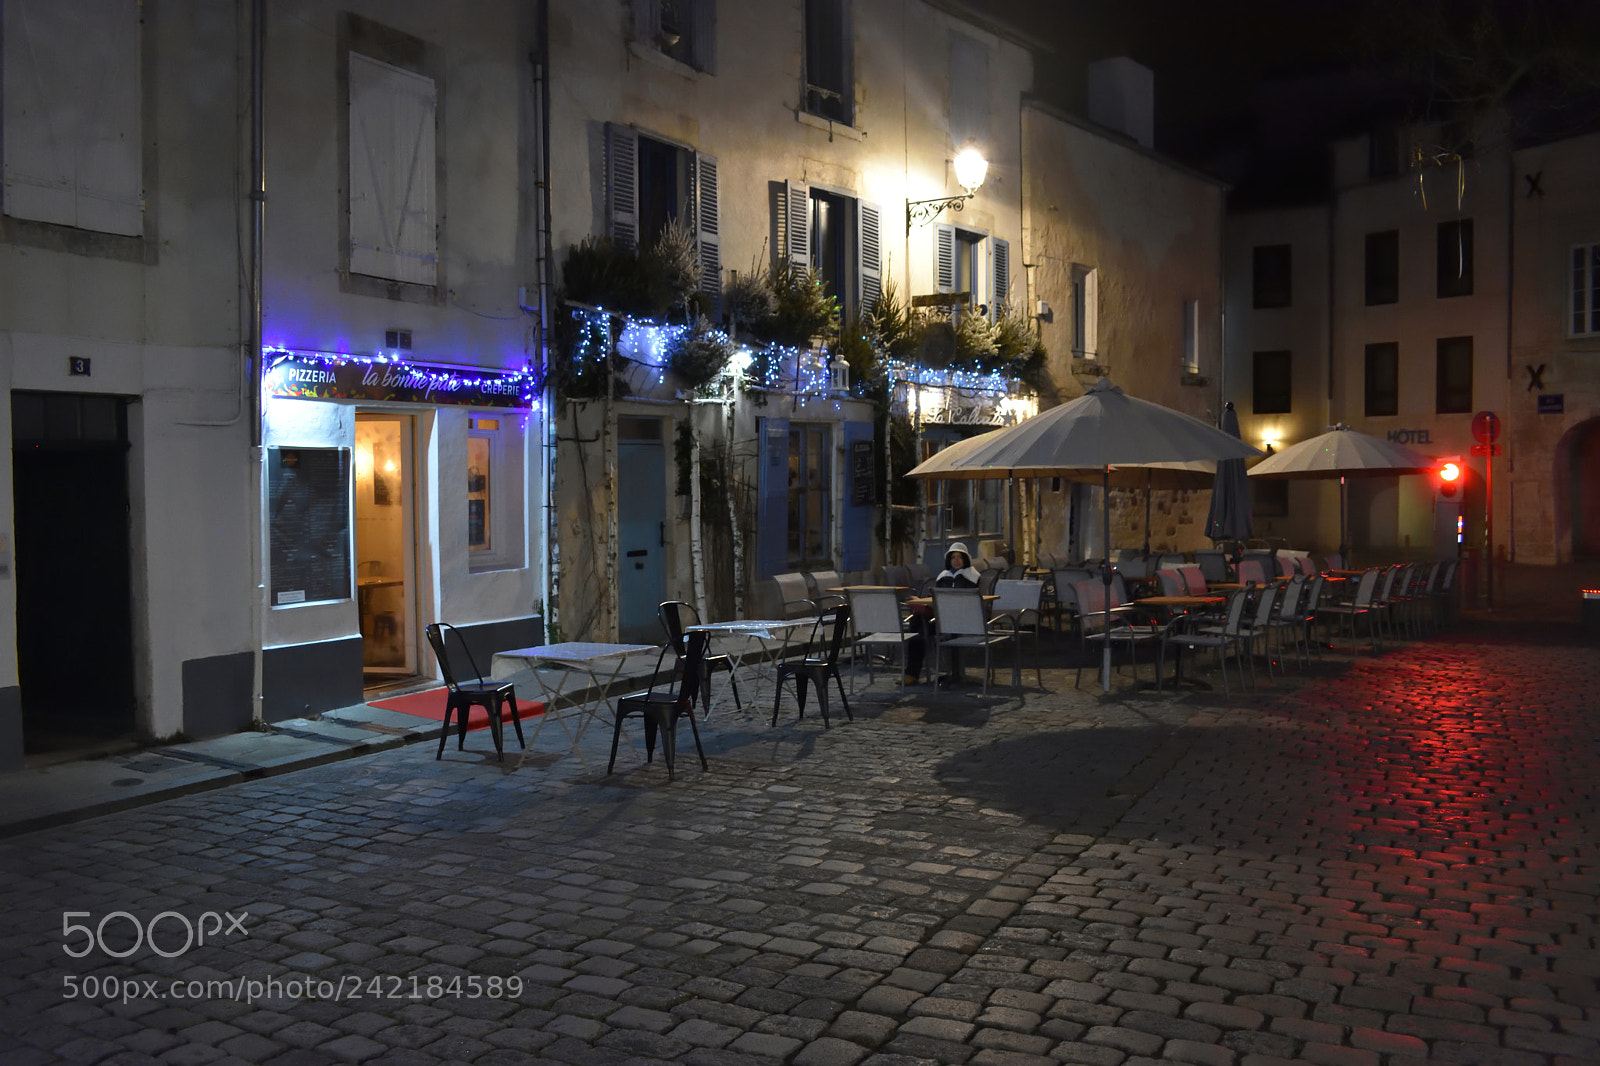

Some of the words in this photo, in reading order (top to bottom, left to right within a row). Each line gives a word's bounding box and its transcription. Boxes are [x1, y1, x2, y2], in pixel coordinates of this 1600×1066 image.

[77, 360, 84, 373] 3
[288, 367, 337, 384] PIZZERIA
[361, 364, 380, 386] la
[381, 365, 427, 390] bonne
